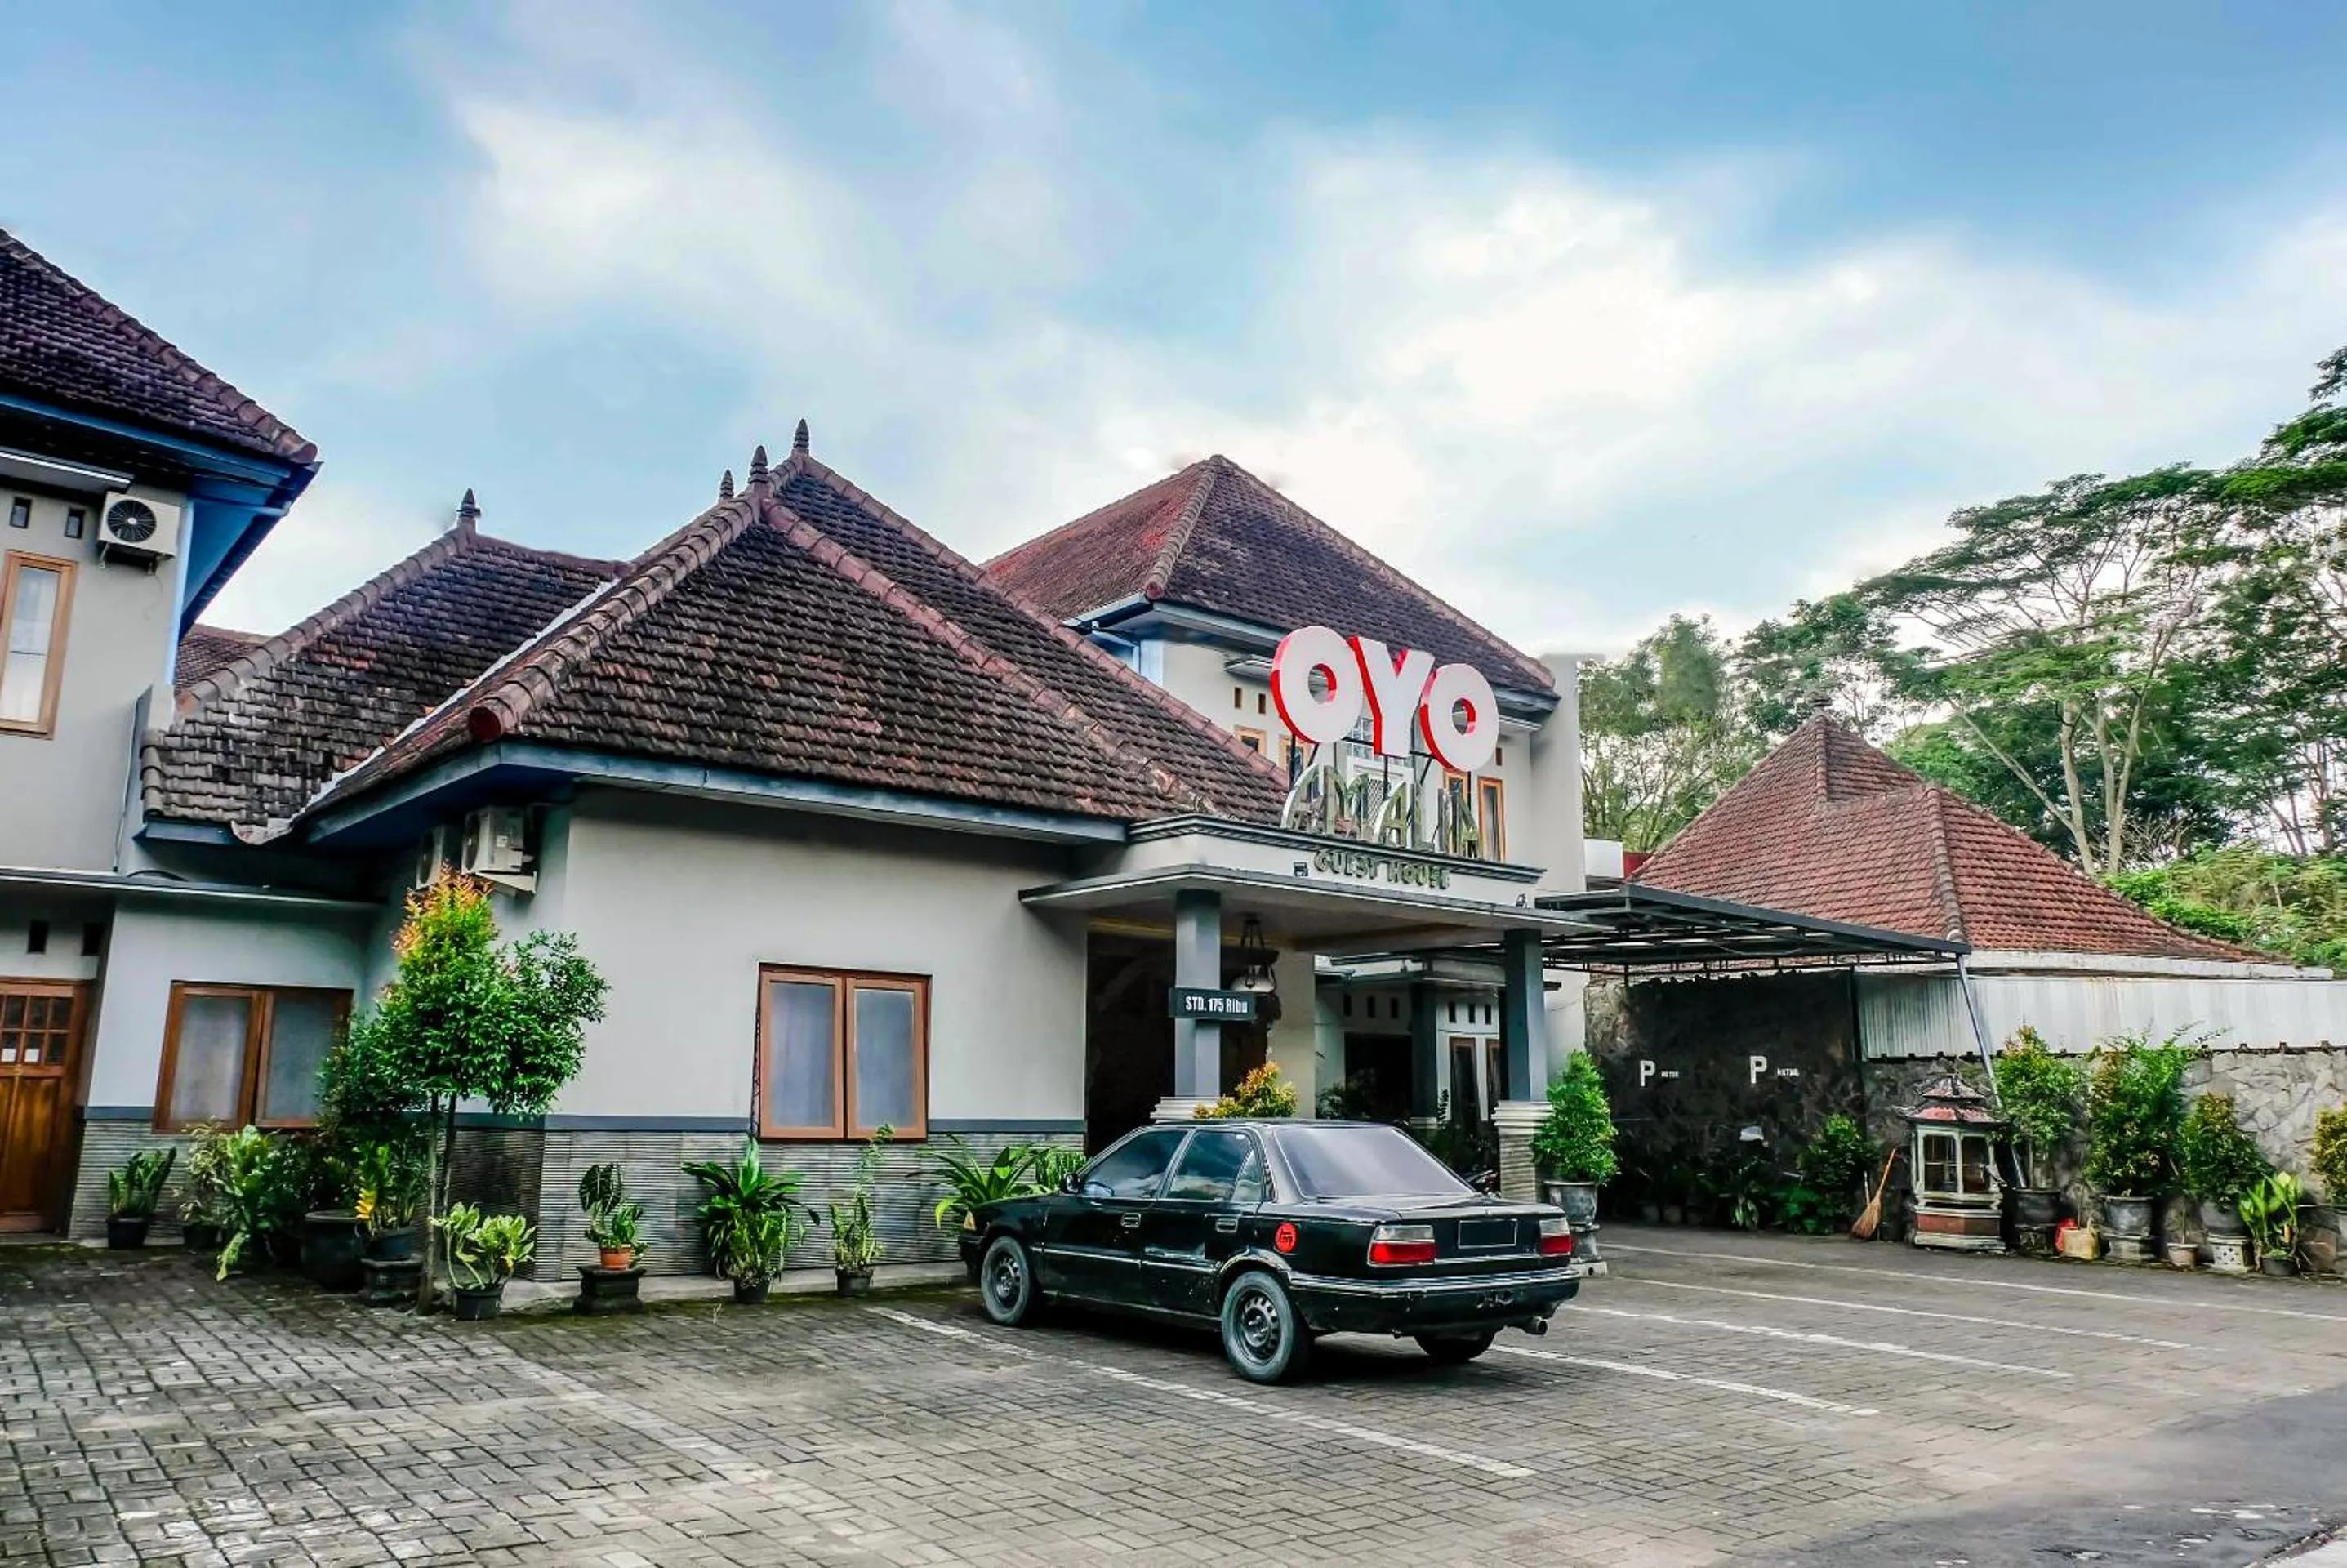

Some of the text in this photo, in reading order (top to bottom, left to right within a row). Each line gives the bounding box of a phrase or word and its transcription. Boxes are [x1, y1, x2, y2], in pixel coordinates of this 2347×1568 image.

[1271, 626, 1499, 773] OYO
[1313, 849, 1451, 889] GUEST HOUSE
[1185, 996, 1207, 1011] STD.
[1208, 997, 1224, 1013] 175
[1640, 1060, 1656, 1087] P
[1749, 1055, 1768, 1085] P
